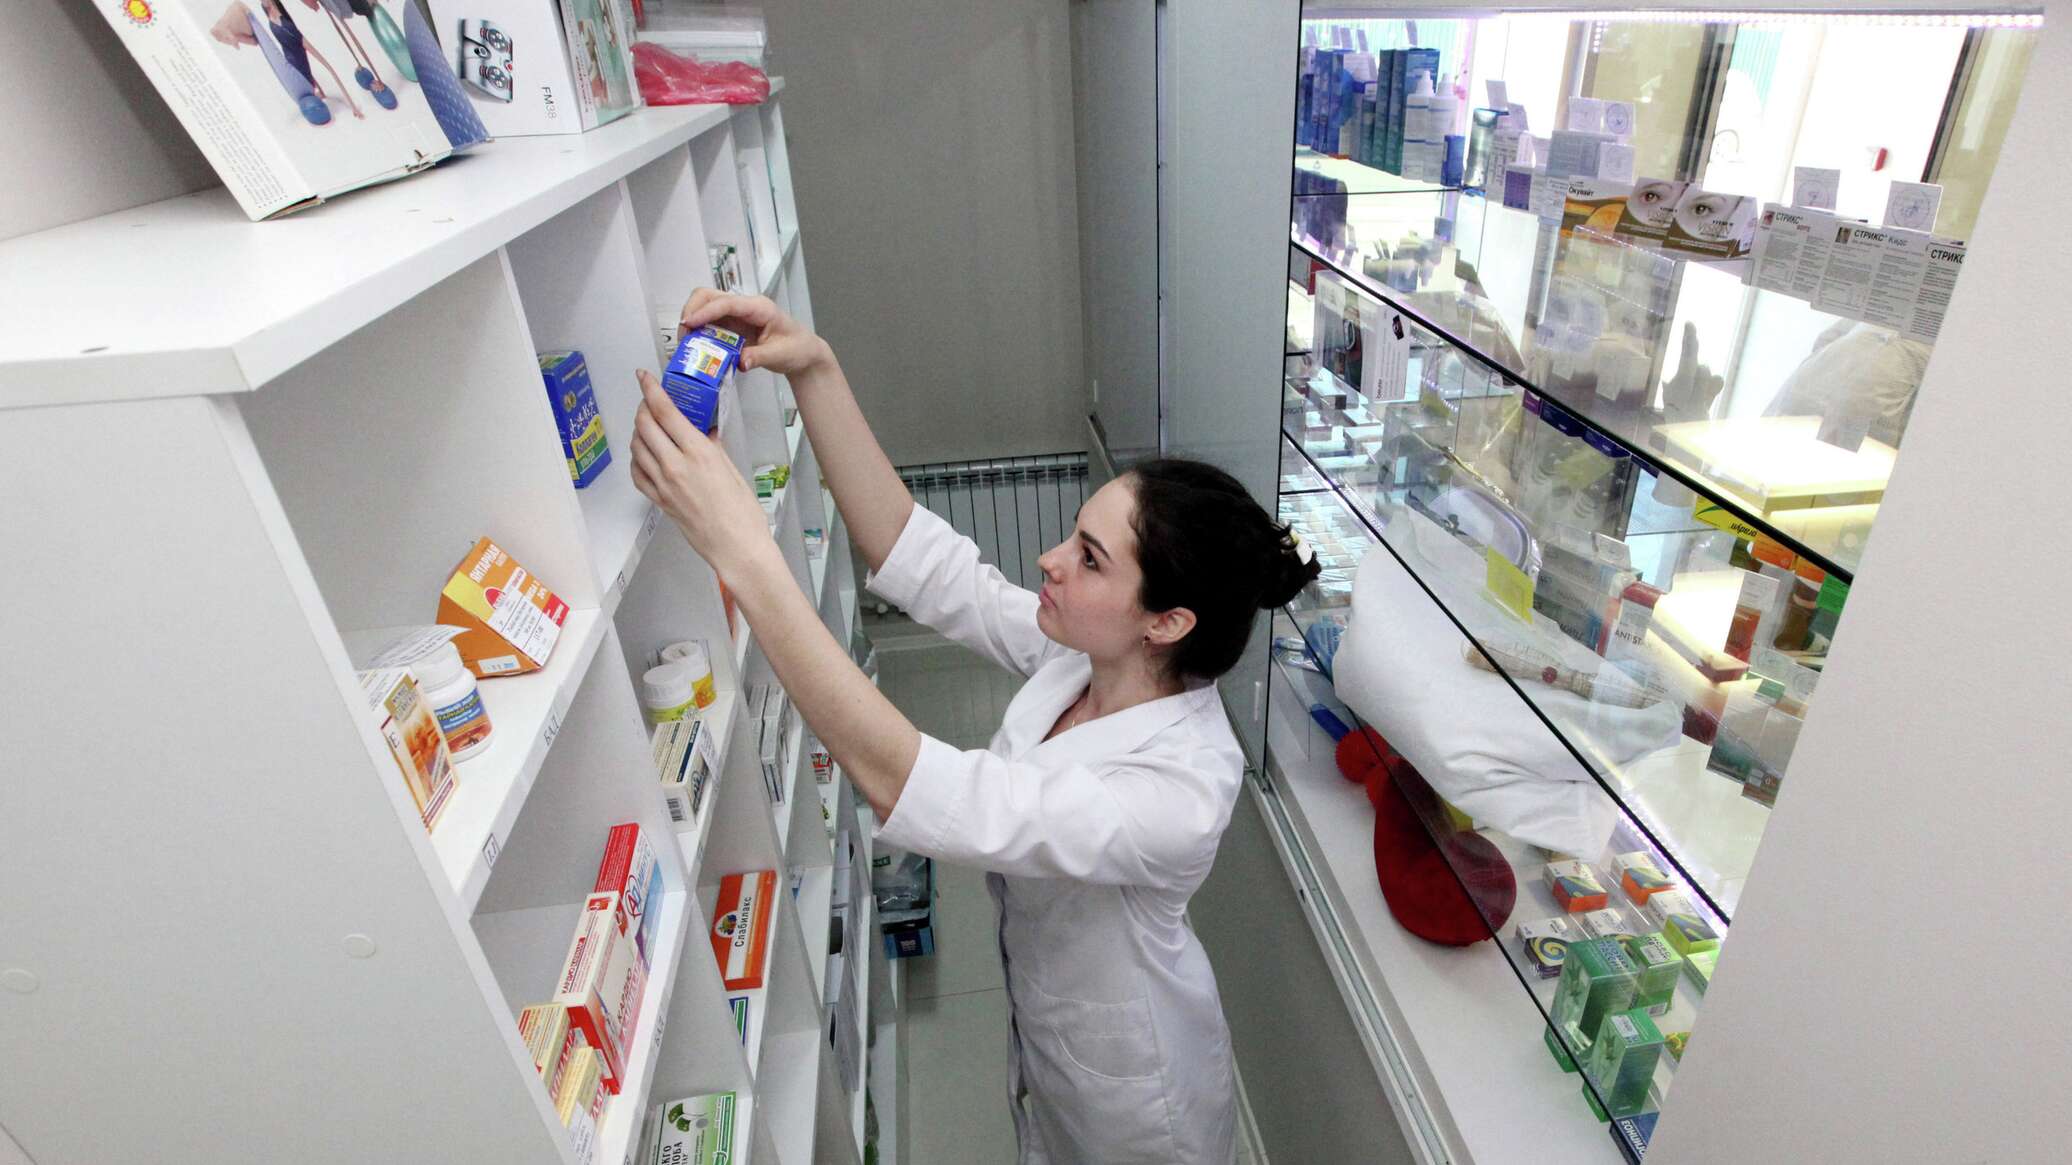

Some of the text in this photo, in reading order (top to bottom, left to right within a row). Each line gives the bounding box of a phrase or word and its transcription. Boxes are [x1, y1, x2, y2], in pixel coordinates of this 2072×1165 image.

[541, 86, 557, 120] FM38
[1854, 229, 1884, 241] СТРИКС
[734, 896, 752, 948] Слабилакс
